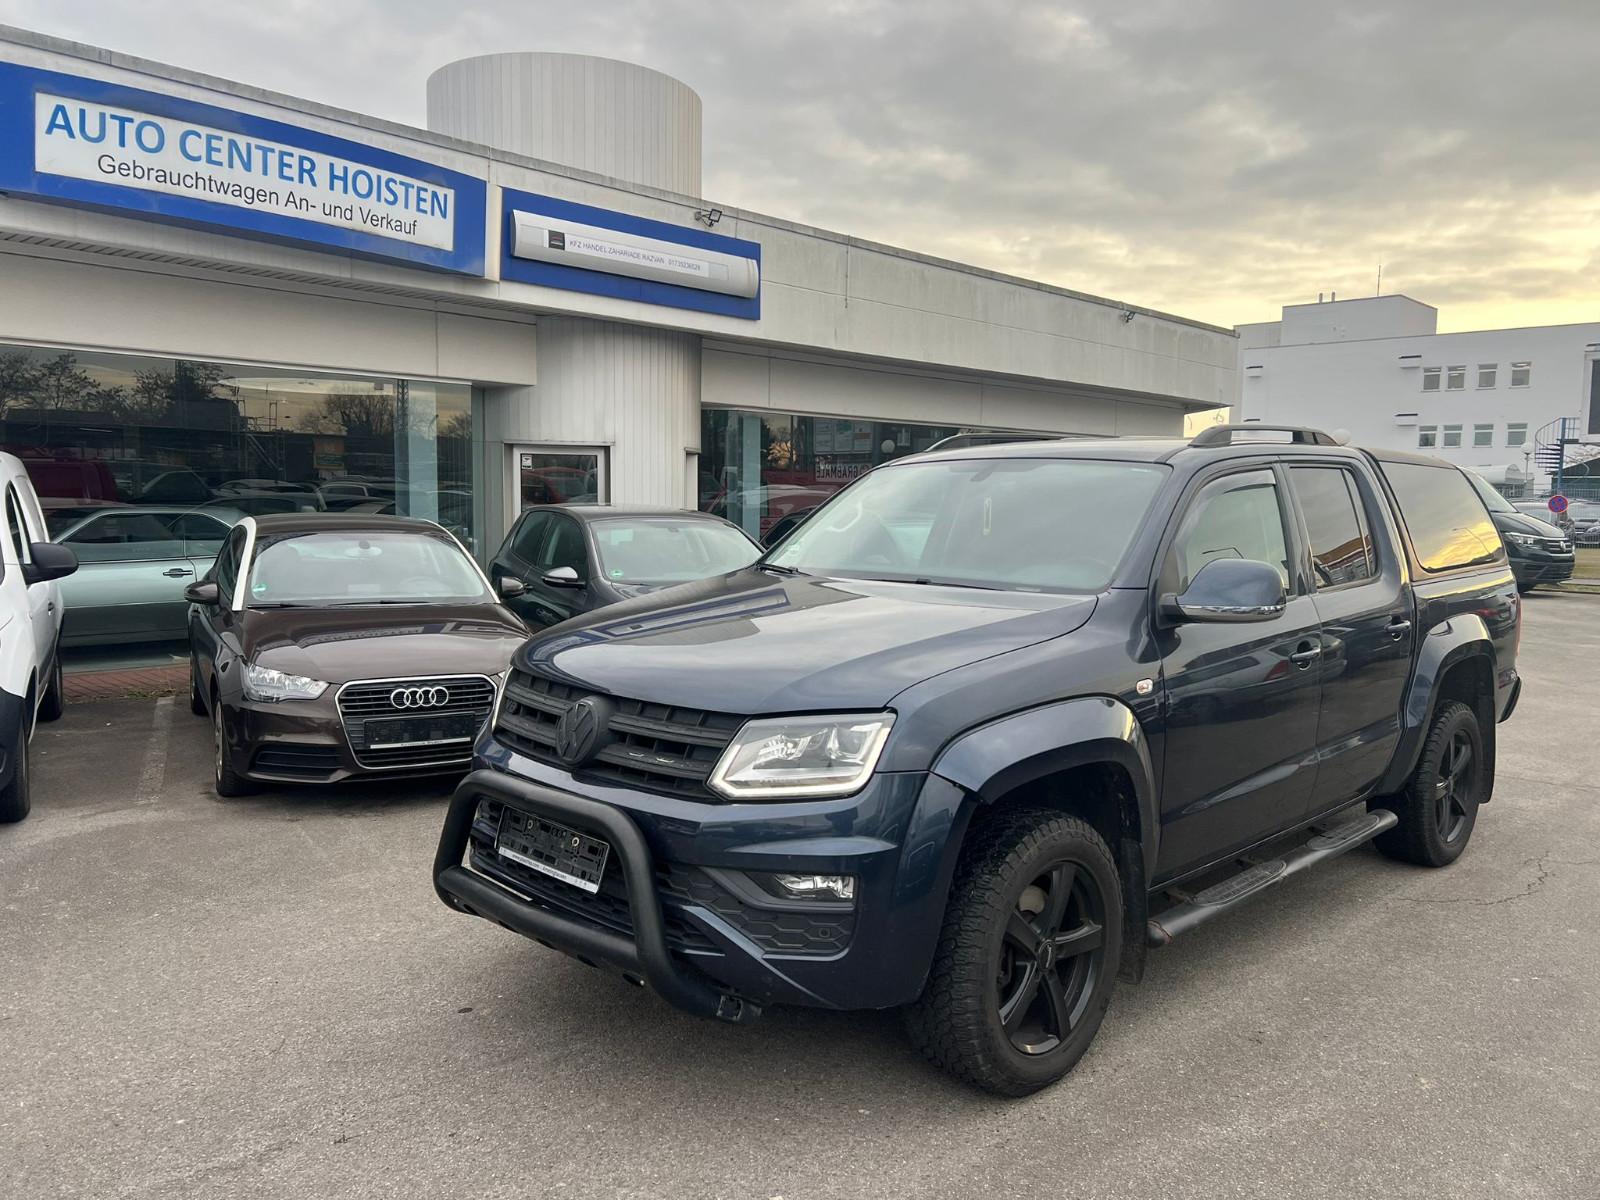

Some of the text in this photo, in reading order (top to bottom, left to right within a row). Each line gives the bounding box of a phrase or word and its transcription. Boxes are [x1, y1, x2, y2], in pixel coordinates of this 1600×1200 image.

[45, 104, 448, 219] AUTO CENTER HOISTEN
[98, 154, 417, 236] Gebrauchtwagen An- und Verkauf
[583, 242, 607, 254] HANDEL
